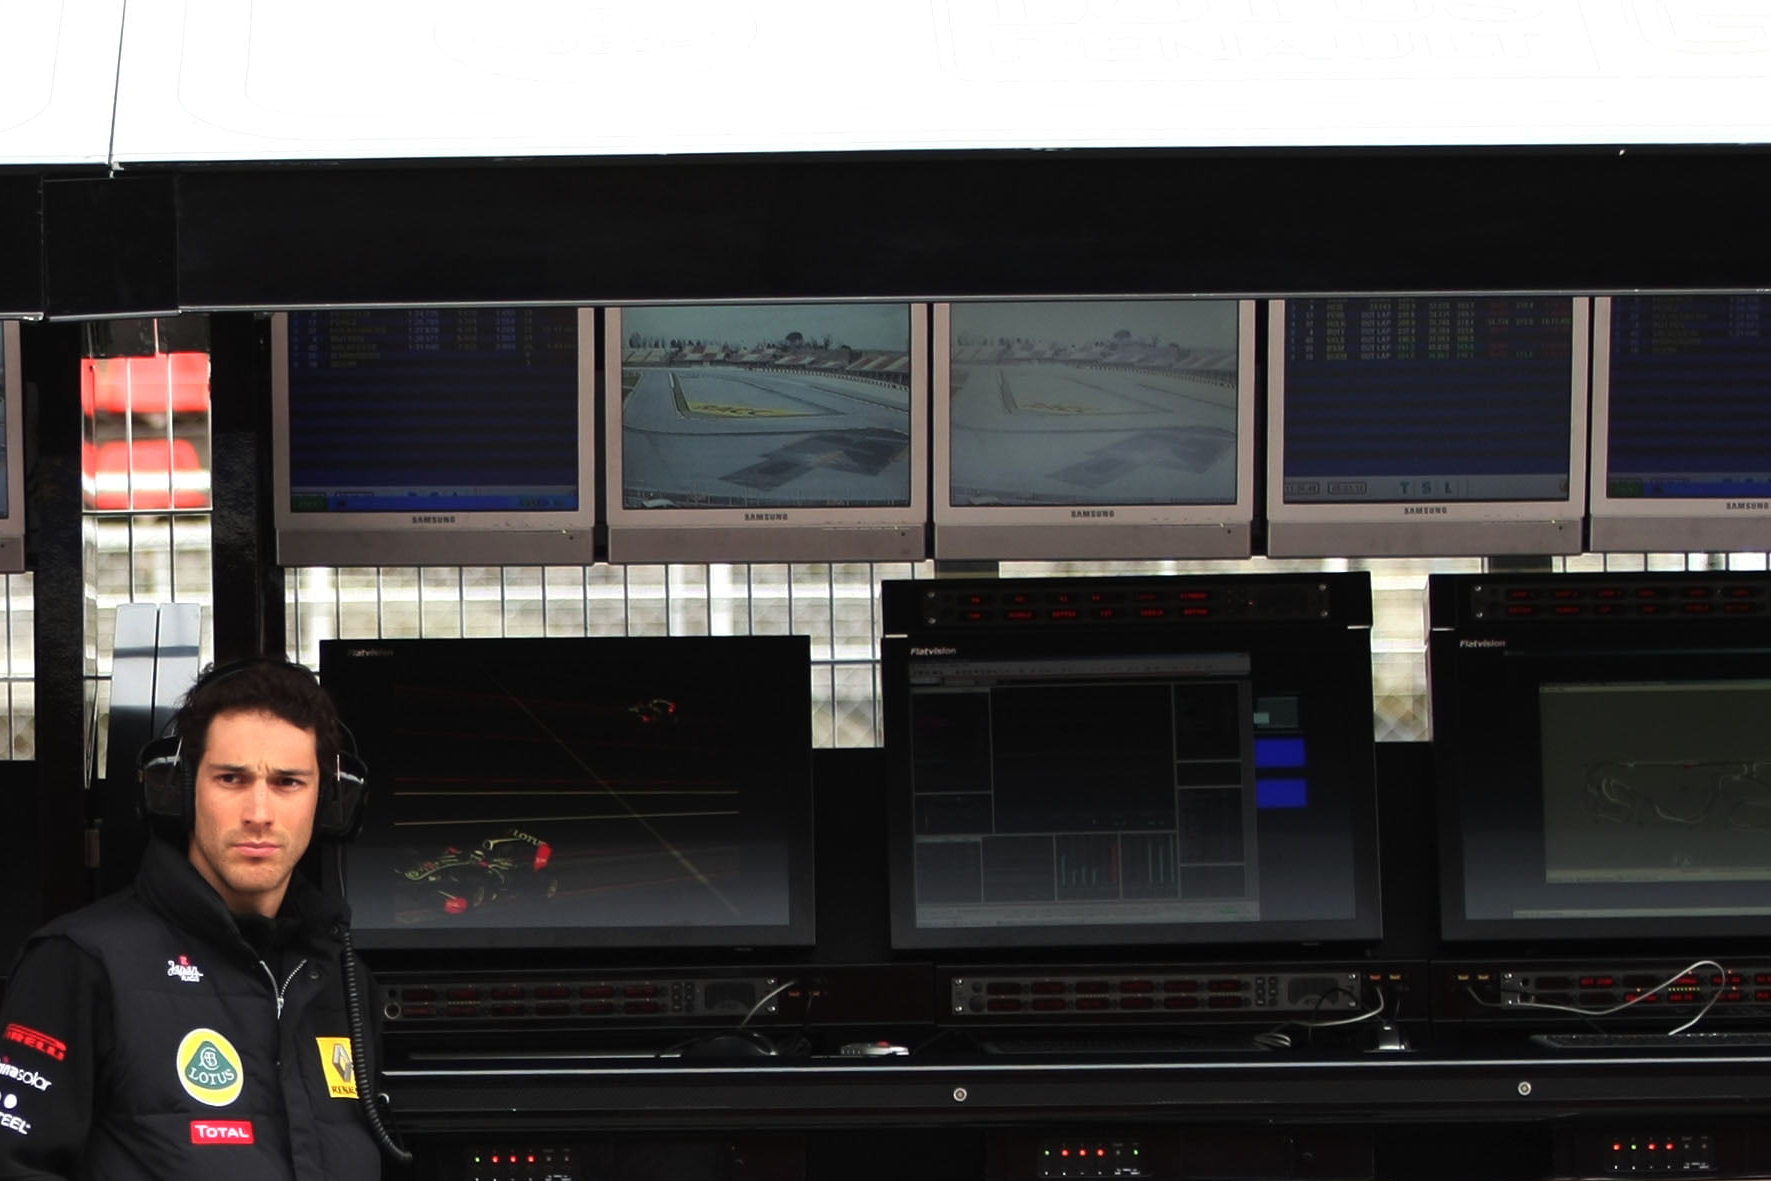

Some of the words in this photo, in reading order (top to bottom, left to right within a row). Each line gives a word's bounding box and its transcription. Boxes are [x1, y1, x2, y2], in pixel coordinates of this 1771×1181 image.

[1404, 506, 1447, 514] SAMSUNG
[1726, 501, 1769, 510] SAMSUNG
[744, 513, 788, 521] SAMSUNG
[1071, 510, 1114, 518] SAMSUNG
[412, 516, 455, 524] SAMSUNG
[1459, 639, 1506, 648] Flatvision
[910, 647, 957, 656] Flatvision
[167, 960, 204, 977] Japan
[188, 1067, 235, 1086] LOTUS
[194, 1124, 250, 1139] TOTAL
